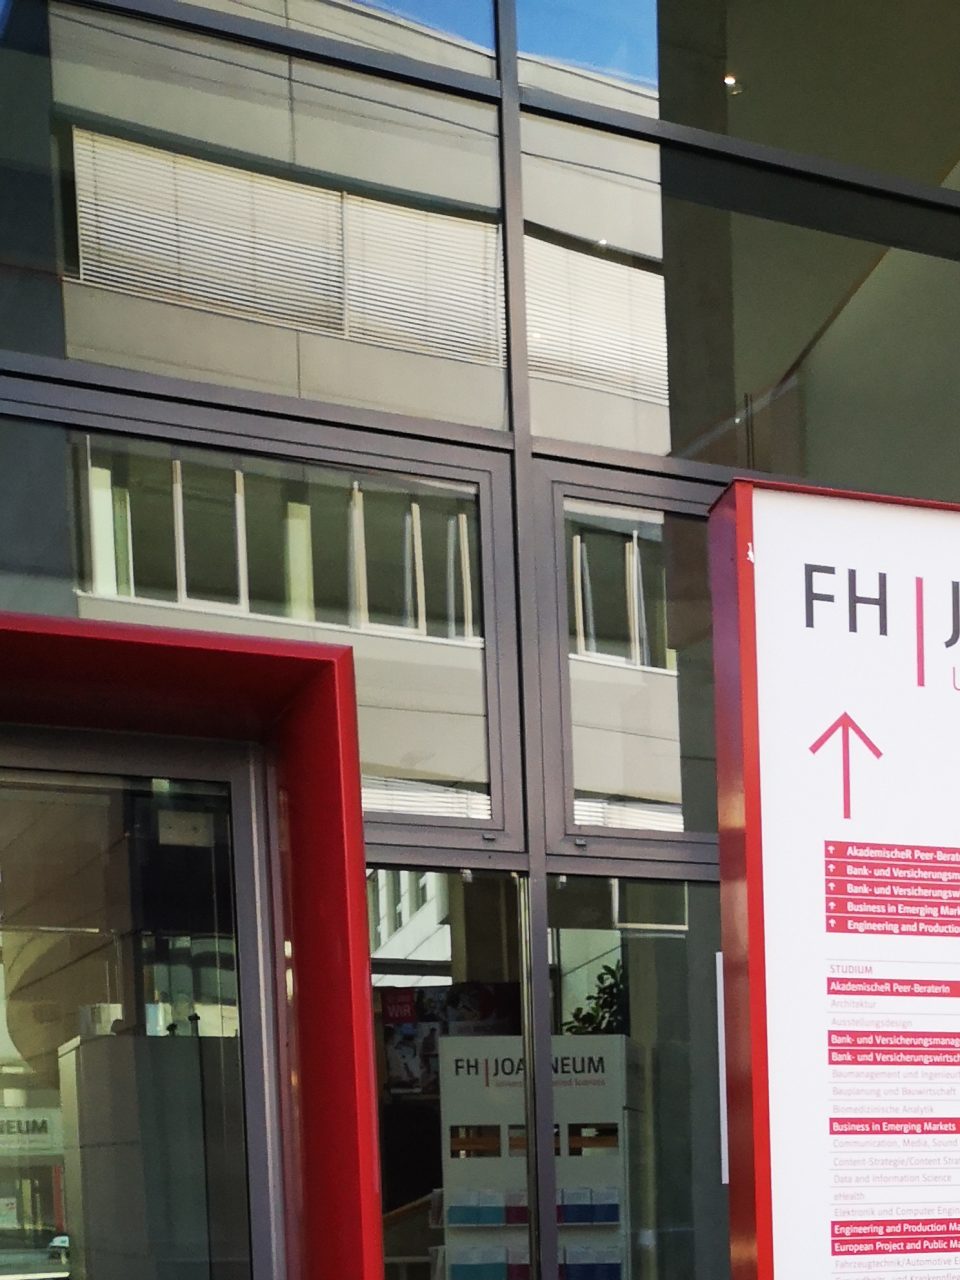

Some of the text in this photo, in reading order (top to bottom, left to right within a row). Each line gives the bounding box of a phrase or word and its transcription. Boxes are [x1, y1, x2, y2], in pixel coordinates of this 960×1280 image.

[804, 564, 888, 636] FH
[847, 847, 912, 859] AkademischeR
[847, 865, 871, 876] Bank-
[874, 867, 890, 877] und
[847, 884, 871, 894] Bank-
[874, 885, 890, 895] und
[847, 902, 885, 913] Business
[888, 904, 896, 914] in
[898, 904, 938, 917] Emerging
[848, 920, 899, 933] Engineering
[901, 922, 917, 932] and
[830, 965, 872, 974] STUDIUM
[831, 983, 890, 992] AkademischeR
[831, 1035, 855, 1044] Bank-
[857, 1035, 873, 1044] und
[832, 1052, 855, 1061] Bank-
[858, 1052, 873, 1061] und
[455, 1056, 605, 1076] FH JOANEUM
[833, 1122, 869, 1131] Business
[872, 1122, 880, 1131] in
[882, 1122, 921, 1133] Emerging
[924, 1122, 956, 1131] Markets
[835, 1224, 884, 1235] Engineering
[886, 1223, 900, 1232] and
[903, 1223, 946, 1232] Production
[835, 1242, 873, 1253] European
[876, 1241, 904, 1252] Project
[907, 1241, 921, 1250] and
[924, 1240, 947, 1249] Public
